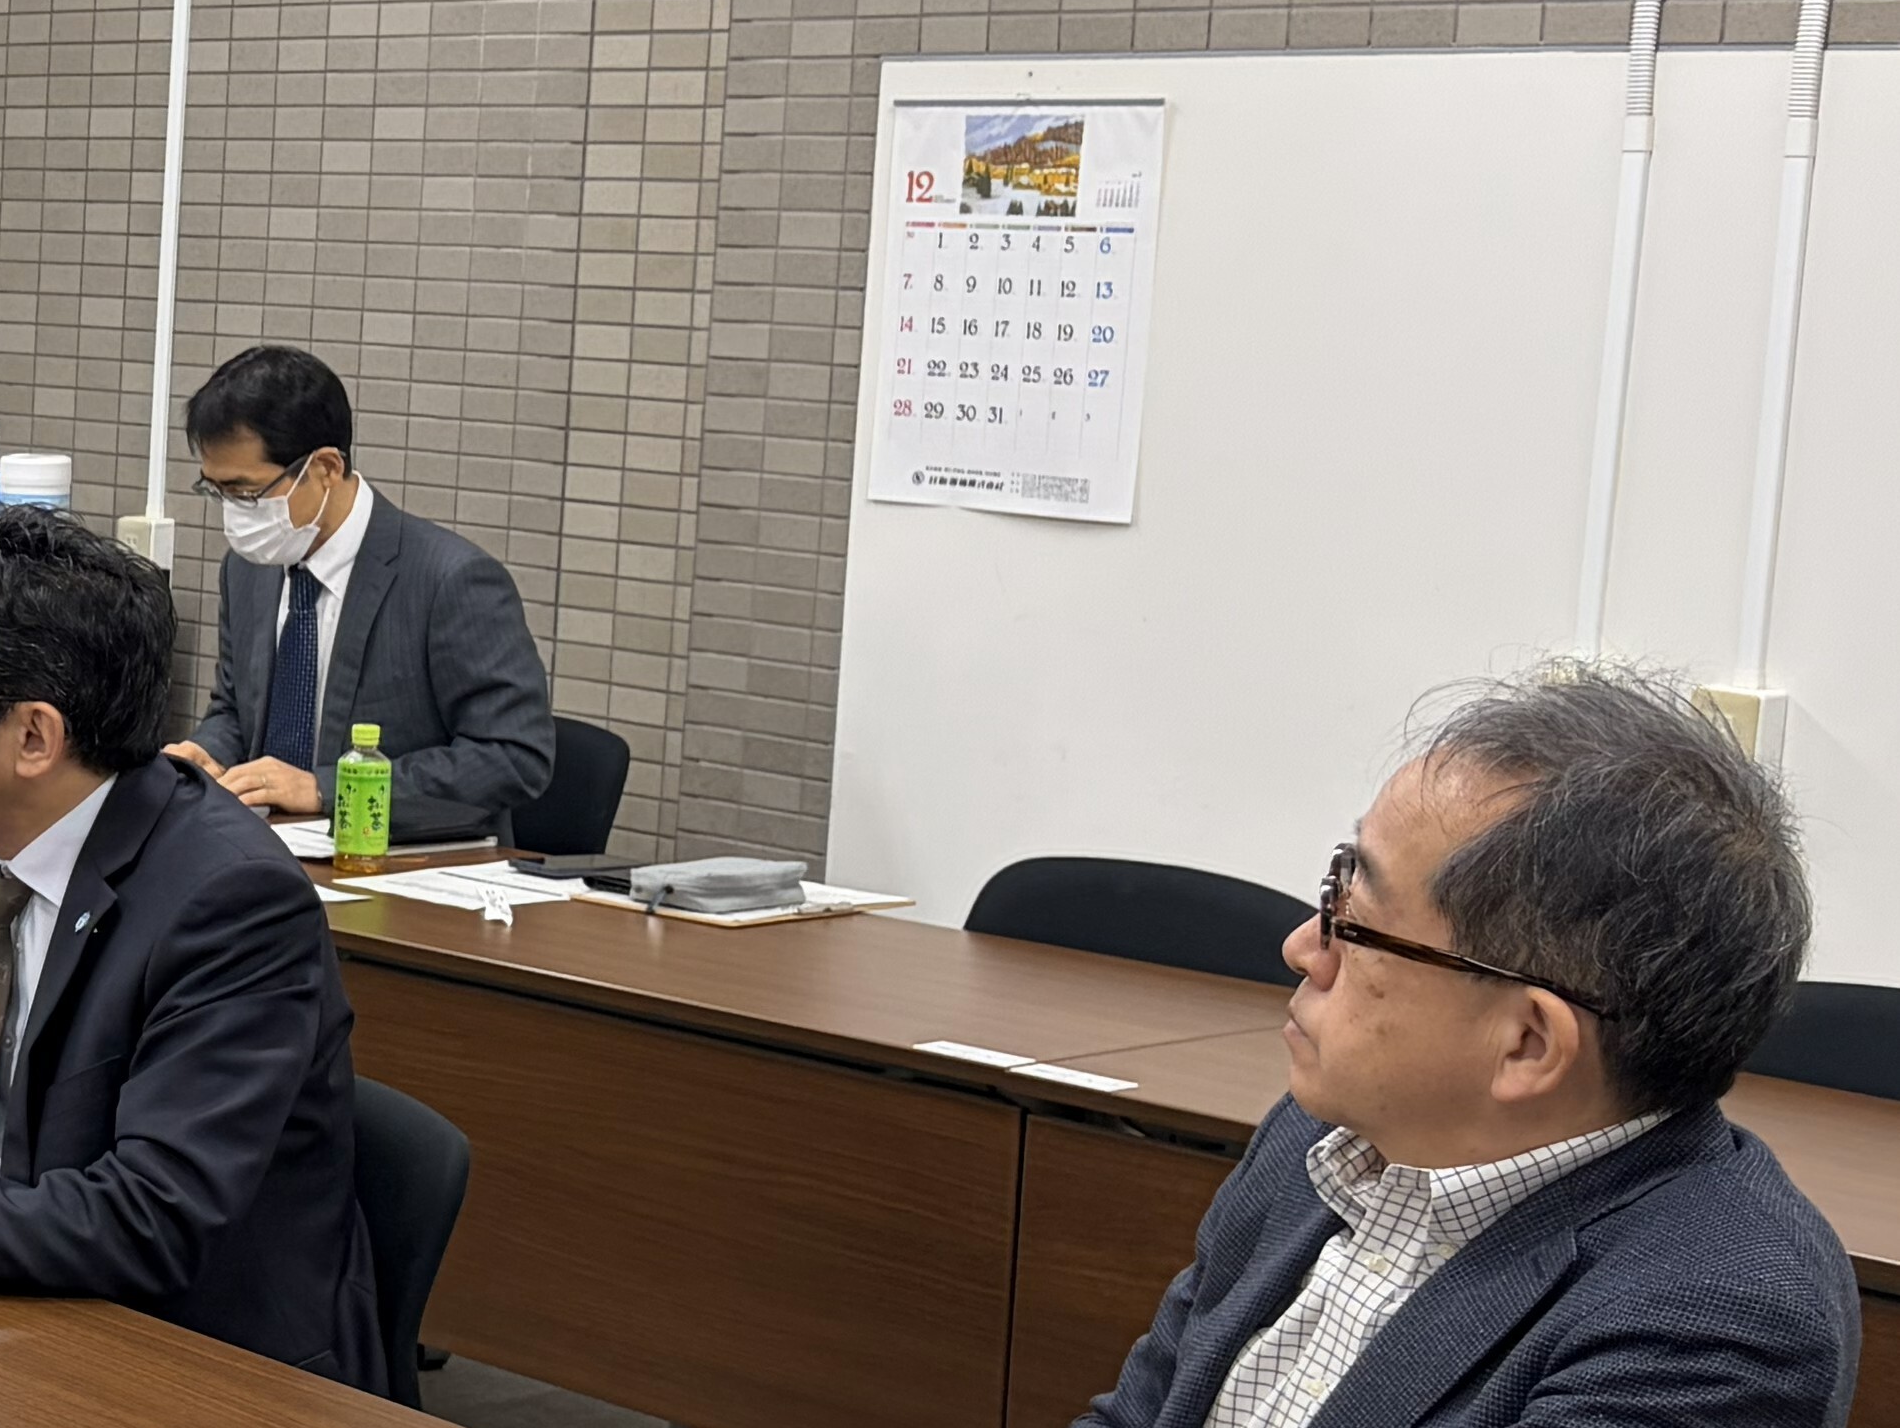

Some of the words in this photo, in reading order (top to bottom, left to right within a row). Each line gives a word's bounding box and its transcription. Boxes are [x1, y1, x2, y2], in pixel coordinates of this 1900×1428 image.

[905, 170, 935, 203] 12
[937, 234, 943, 249] 1
[969, 235, 980, 251] 2
[1001, 235, 1011, 251] 3
[1032, 236, 1041, 252] 4
[1064, 237, 1074, 253] 5
[1100, 237, 1111, 254] 6
[903, 274, 911, 290] 7
[934, 275, 943, 292] 8
[966, 277, 976, 293] 9
[998, 278, 1013, 295] 10
[1029, 279, 1042, 296] 11
[1061, 281, 1076, 297] 12
[1096, 282, 1113, 299] 13
[900, 316, 913, 332] 14
[931, 317, 946, 334] 15
[963, 320, 978, 336] 16
[995, 321, 1009, 337] 17
[1026, 322, 1042, 339] 18
[1057, 324, 1073, 341] 19
[1091, 326, 1115, 343] 20
[897, 358, 911, 375] 21
[927, 361, 947, 377] 22
[959, 362, 979, 379] 23
[991, 364, 1008, 382] 24
[1022, 367, 1041, 383] 25
[1053, 368, 1074, 385] 26
[1087, 371, 1110, 387] 27
[893, 400, 912, 416] 28
[924, 402, 944, 419] 29
[956, 404, 977, 421] 30
[988, 406, 1003, 423] 31
